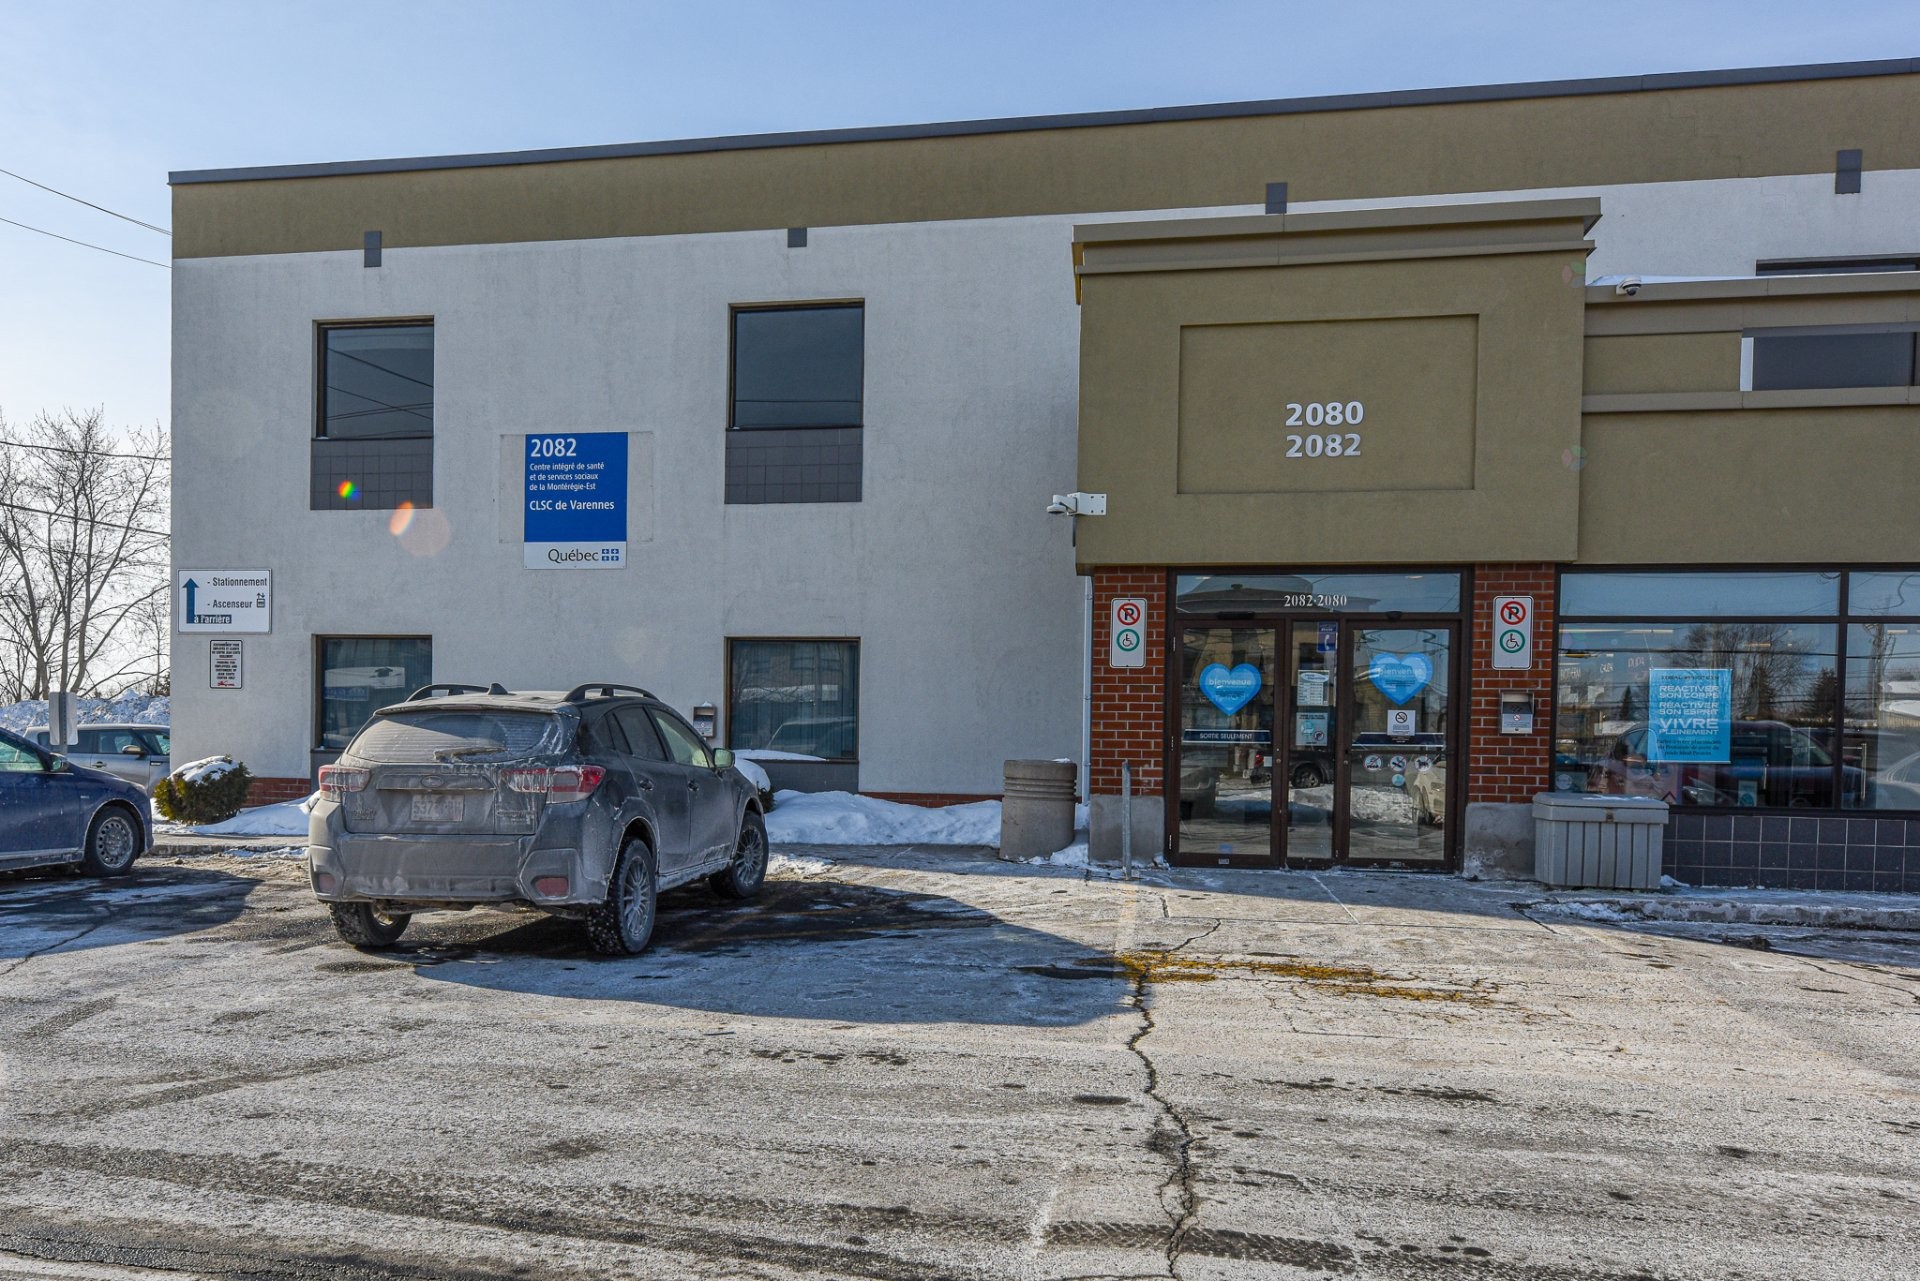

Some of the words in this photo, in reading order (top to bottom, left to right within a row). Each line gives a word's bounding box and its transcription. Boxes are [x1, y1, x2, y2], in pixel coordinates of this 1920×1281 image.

[1286, 401, 1364, 426] 2080
[530, 438, 577, 457] 2082
[1286, 433, 1361, 457] 2082
[529, 463, 551, 471] Centre
[552, 462, 575, 472] intégré
[576, 462, 585, 470] de
[586, 462, 605, 470] santé
[538, 473, 546, 481] de
[547, 473, 573, 481] services
[574, 472, 599, 480] sociaux
[529, 483, 538, 491] de
[539, 483, 546, 491] la
[547, 482, 596, 492] Montérégie-Est
[529, 500, 553, 511] CLSC
[555, 500, 567, 510] de
[570, 500, 615, 510] Varennes
[548, 548, 599, 564] Québec
[213, 577, 268, 587] Stationnement
[212, 599, 253, 609] Ascenseur
[1660, 718, 1719, 729] VIVRE
